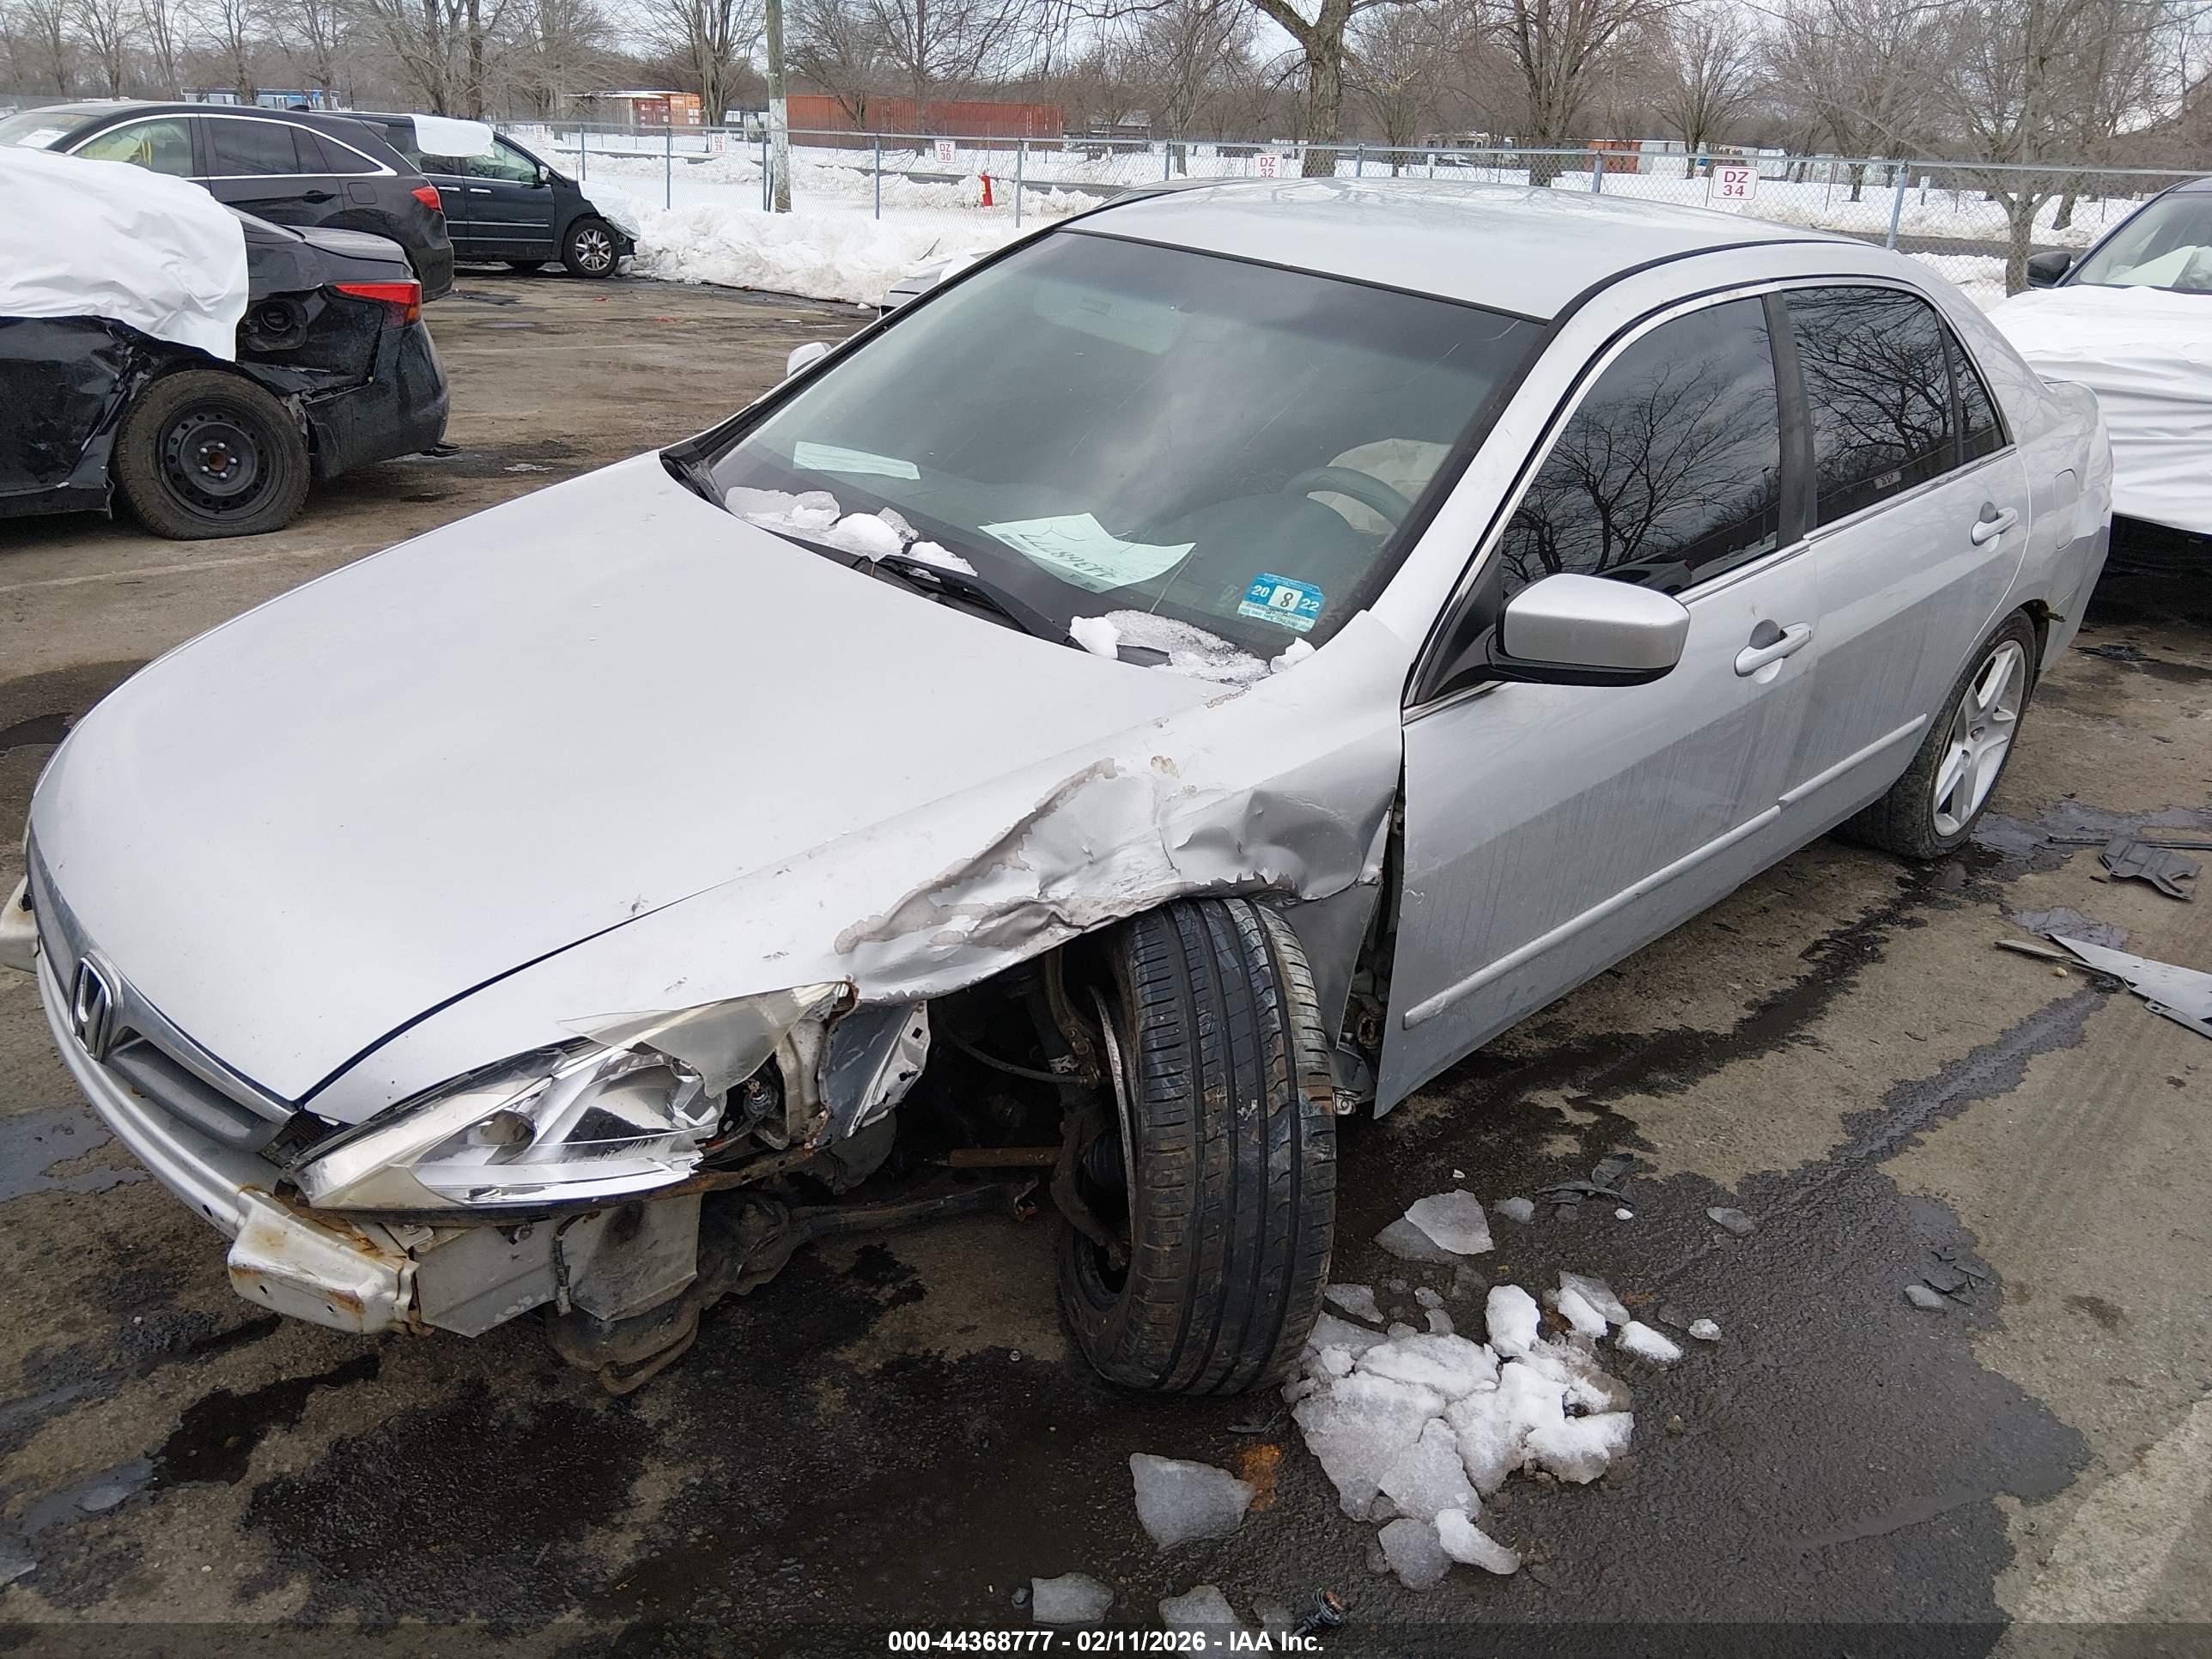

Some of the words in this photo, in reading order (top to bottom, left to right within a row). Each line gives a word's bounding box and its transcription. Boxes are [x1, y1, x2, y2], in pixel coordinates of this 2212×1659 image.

[940, 143, 951, 152] DZ
[1260, 157, 1276, 167] DZ
[1261, 168, 1274, 178] 32
[1724, 171, 1749, 183] DZ
[1723, 185, 1745, 197] 34
[1251, 585, 1270, 598] 20
[1279, 592, 1294, 608] 8
[1300, 599, 1320, 612] 22
